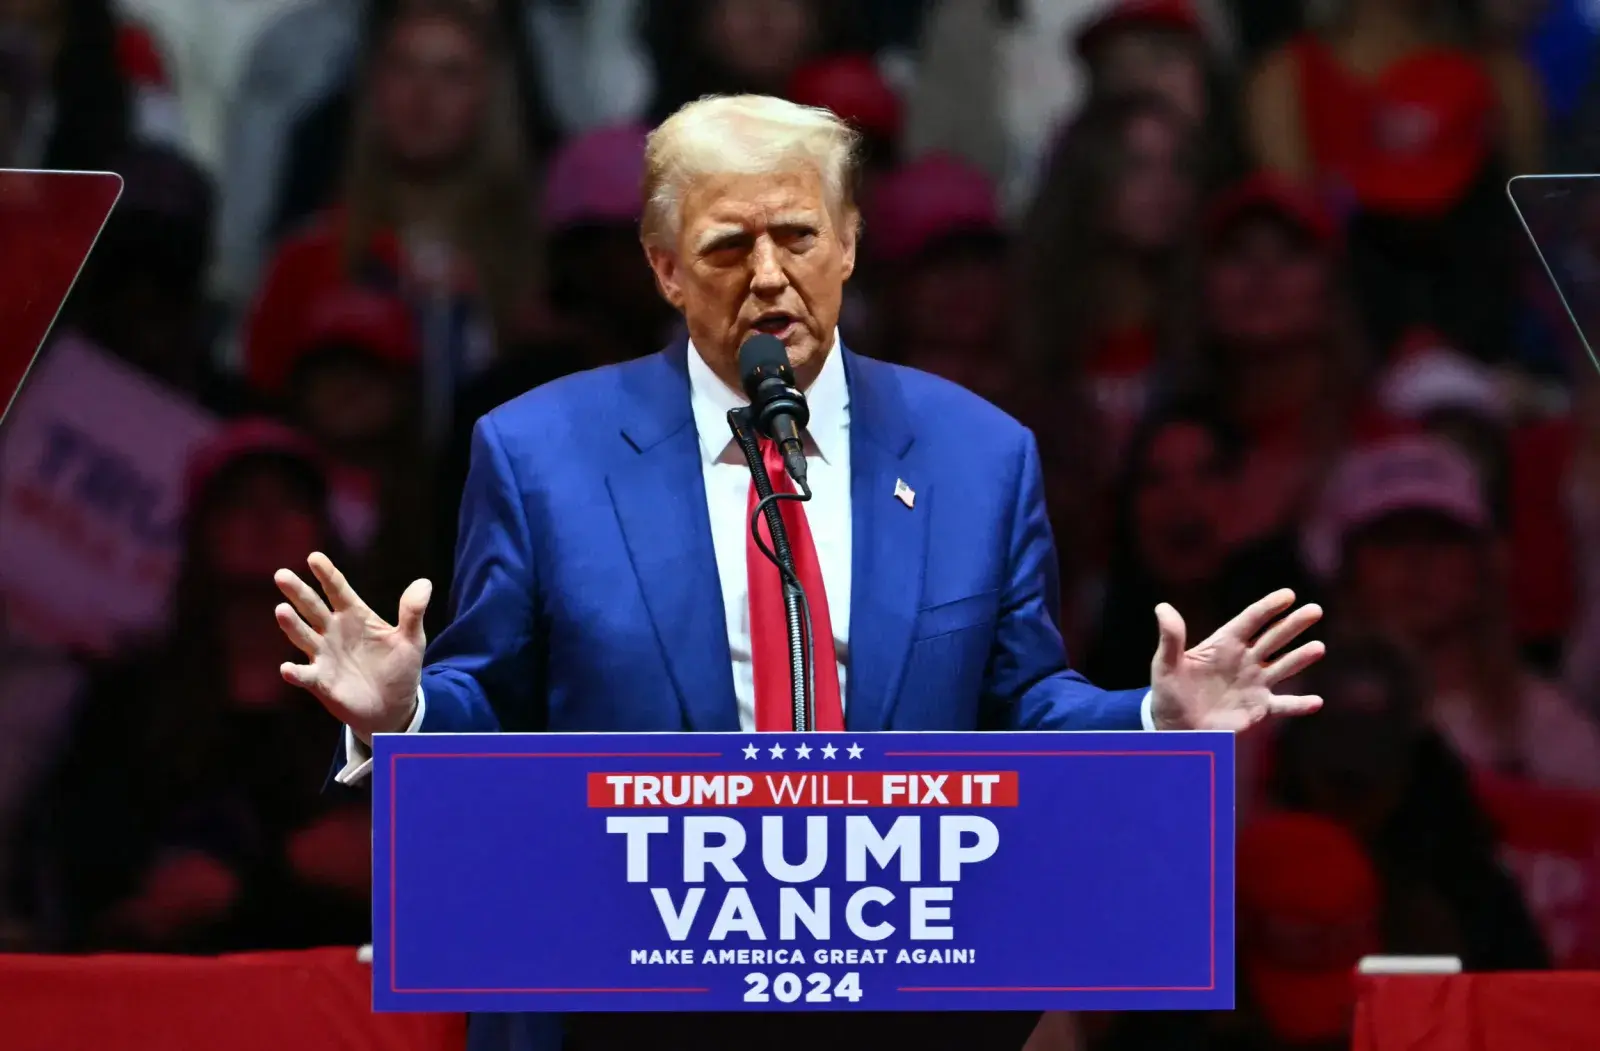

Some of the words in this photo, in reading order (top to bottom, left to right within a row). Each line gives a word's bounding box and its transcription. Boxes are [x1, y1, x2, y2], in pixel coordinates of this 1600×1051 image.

[606, 774, 754, 806] TRUMP
[765, 774, 869, 806] WILL
[882, 774, 950, 806] FIX
[961, 774, 1000, 806] IT
[606, 815, 1000, 883] TRUMP
[650, 886, 955, 942] VANCE
[630, 949, 694, 965] MAKE
[701, 949, 806, 965] AMERICA
[813, 948, 889, 966] GREAT
[895, 948, 976, 966] AGAIN!
[743, 971, 863, 1003] 2024
